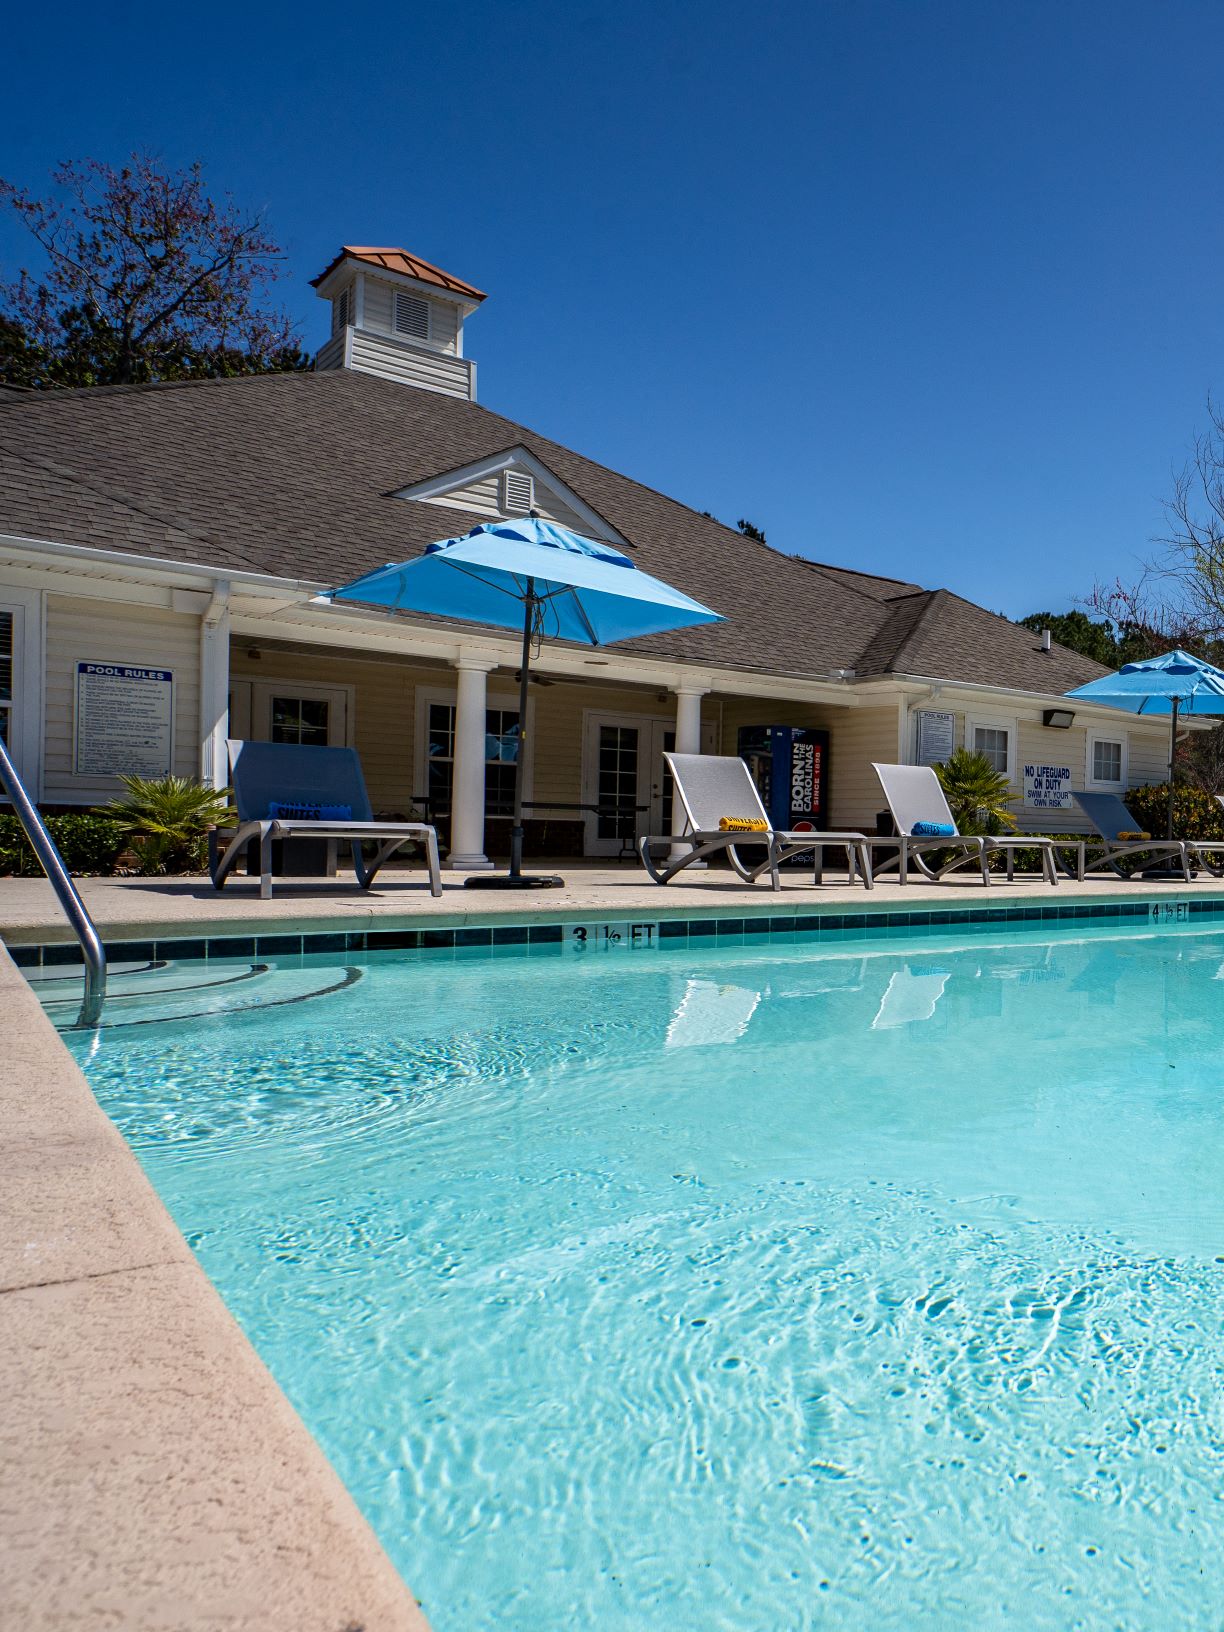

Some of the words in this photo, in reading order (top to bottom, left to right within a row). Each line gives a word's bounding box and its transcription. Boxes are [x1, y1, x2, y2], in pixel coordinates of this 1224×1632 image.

[87, 665, 121, 676] POOL
[124, 669, 165, 680] RULES
[793, 743, 800, 758] IN
[804, 744, 814, 812] CAROLINAS
[1025, 766, 1034, 777] NO
[1037, 766, 1070, 779] LIFEGUARD
[791, 760, 805, 812] BORN
[1034, 778, 1043, 790] ON
[1046, 779, 1061, 790] DUTY
[1027, 790, 1041, 798] SWIM
[1044, 790, 1051, 798] AT
[1053, 791, 1069, 799] YOUR
[1034, 799, 1047, 807] OWN
[1049, 799, 1062, 807] RISK
[791, 855, 815, 863] peps
